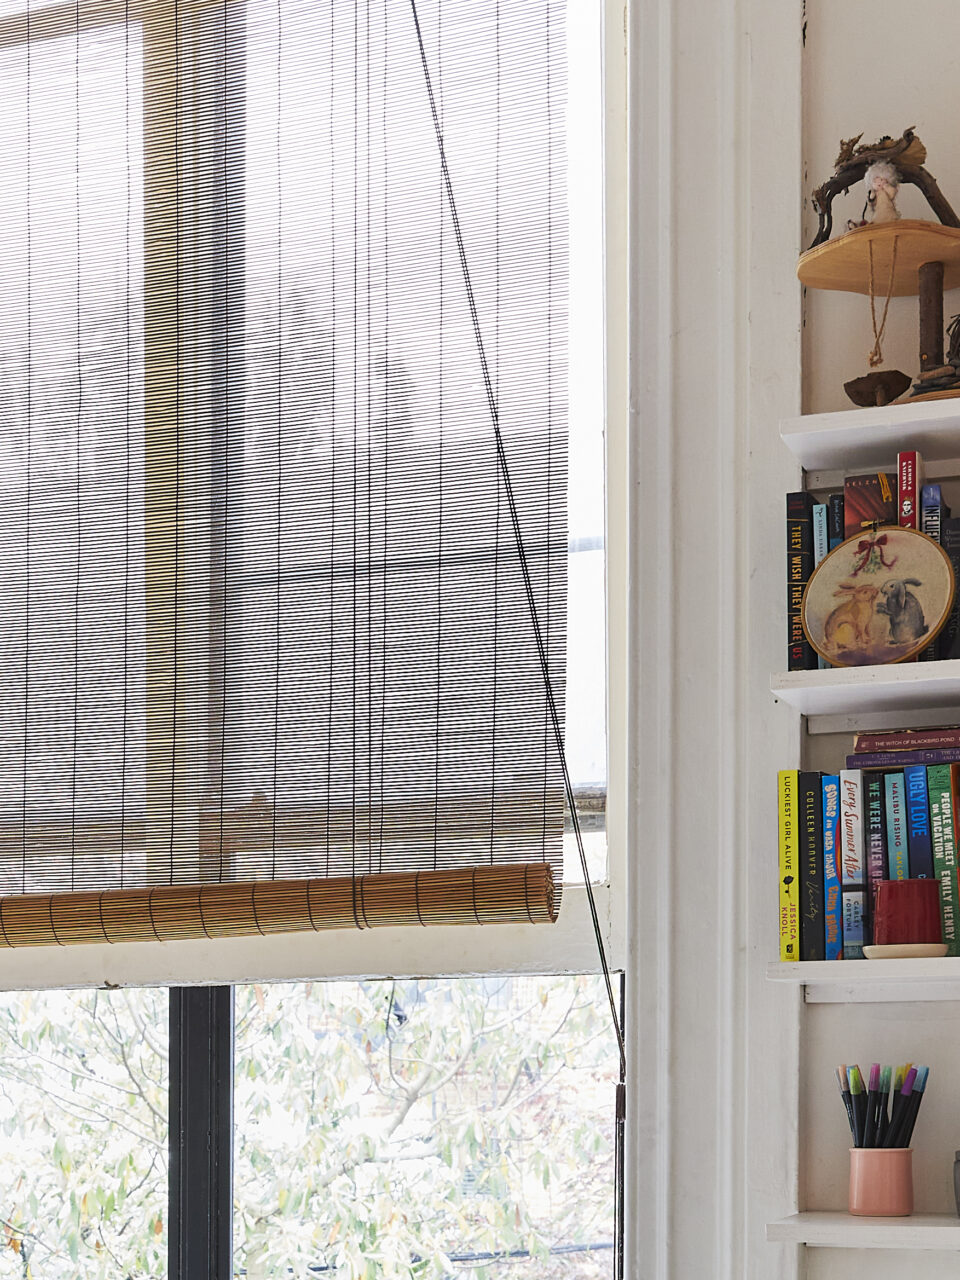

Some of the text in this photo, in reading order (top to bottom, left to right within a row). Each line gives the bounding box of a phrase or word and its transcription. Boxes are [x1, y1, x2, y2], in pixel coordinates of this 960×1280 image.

[792, 526, 802, 659] THEY WISH THEY WERE US
[825, 784, 837, 817] SONGS
[869, 782, 879, 797] WE
[892, 782, 900, 814] MALIBU
[908, 772, 927, 837] UGLY LOVE
[806, 792, 815, 833] COLLEEN
[870, 801, 880, 829] WERE
[940, 792, 951, 824] PEOPLE
[844, 780, 860, 880] Every Summer After
[893, 818, 901, 847] RISING
[932, 816, 942, 858] VACATION
[942, 827, 952, 841] WE
[870, 833, 882, 867] NEVER
[944, 843, 954, 866] MEET
[940, 871, 954, 940] EMILY HENRY
